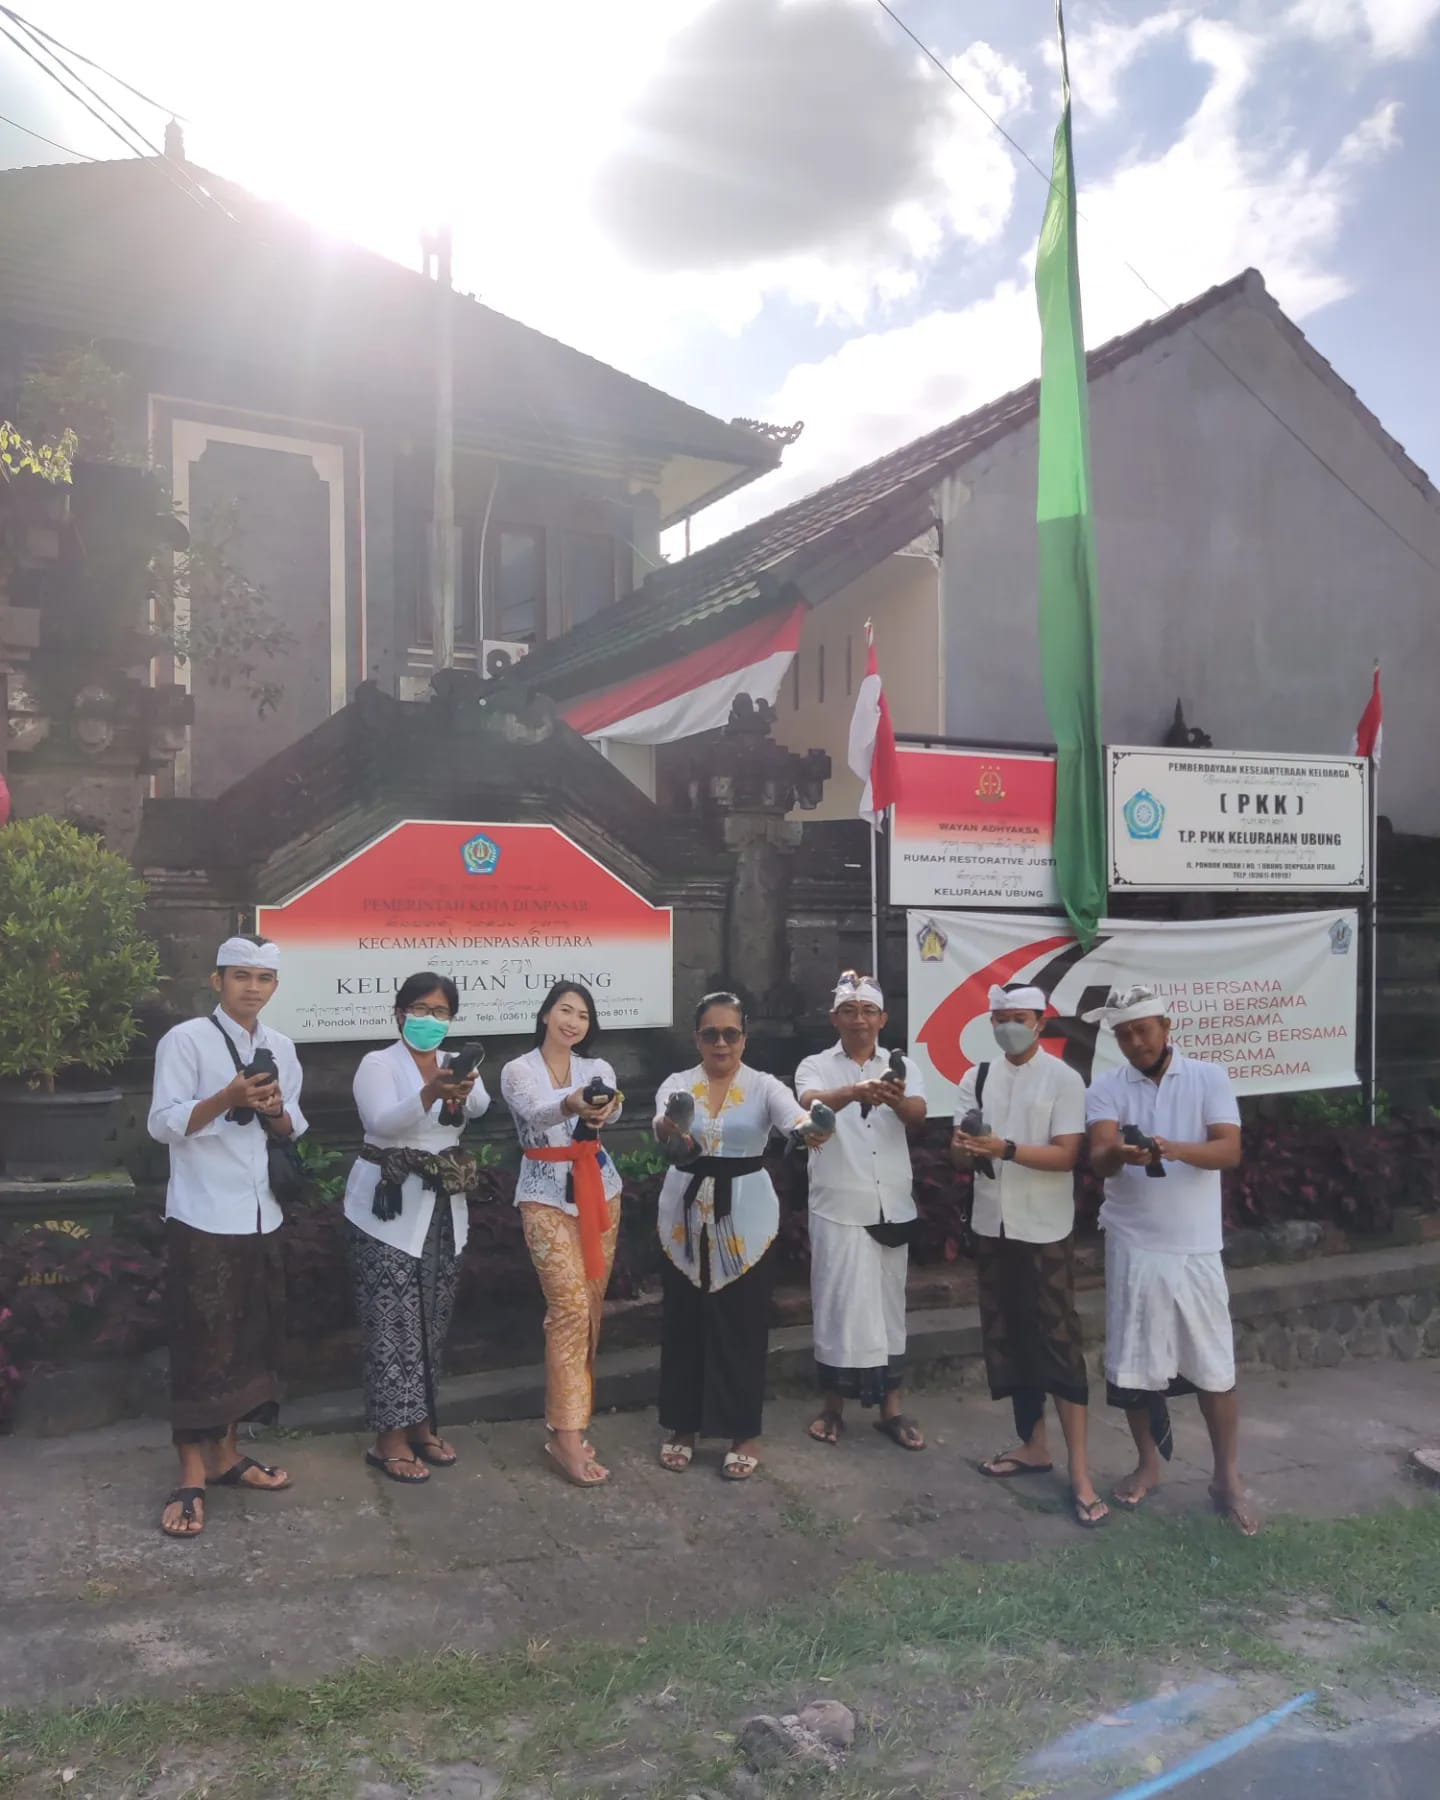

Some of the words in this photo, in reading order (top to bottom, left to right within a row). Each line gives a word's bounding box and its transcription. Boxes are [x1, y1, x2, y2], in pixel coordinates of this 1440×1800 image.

[1168, 762, 1237, 774] PEMBERDAYAAN
[1308, 767, 1350, 778] KELUARGA
[939, 823, 978, 832] WAYAN
[981, 824, 1040, 834] ADHYAKSA
[1200, 831, 1225, 844] PKK
[1228, 831, 1298, 845] KELURAHAN
[1300, 832, 1342, 846] UBUNG
[903, 854, 946, 863] RUMAH
[950, 855, 1024, 866] RESTORATIVE
[1027, 857, 1057, 867] JUSTI
[934, 888, 1002, 897] KELURAHAN
[1005, 889, 1044, 898] UBUNG
[363, 898, 464, 912] PEMERINTAH
[469, 899, 511, 912] KOTA
[513, 899, 589, 912] DENPASAR
[359, 936, 458, 949] KECAMATAN
[463, 936, 540, 949] DENPASAR
[544, 935, 593, 948] UTARA
[336, 975, 508, 994] KELUHAN
[1192, 980, 1282, 995] BERSAMA
[1223, 995, 1307, 1011] BERSAMA
[318, 1017, 356, 1028] Pondok
[360, 1016, 390, 1026] Indah
[476, 1013, 497, 1023] Telp.
[500, 1012, 528, 1022] (0361)
[1199, 1013, 1284, 1029] BERSAMA
[1169, 1030, 1262, 1048] KEMBANG
[1267, 1025, 1348, 1042] BERSAMA
[1187, 1047, 1276, 1063] BERSAMA
[1227, 1061, 1312, 1079] BERSAMA
